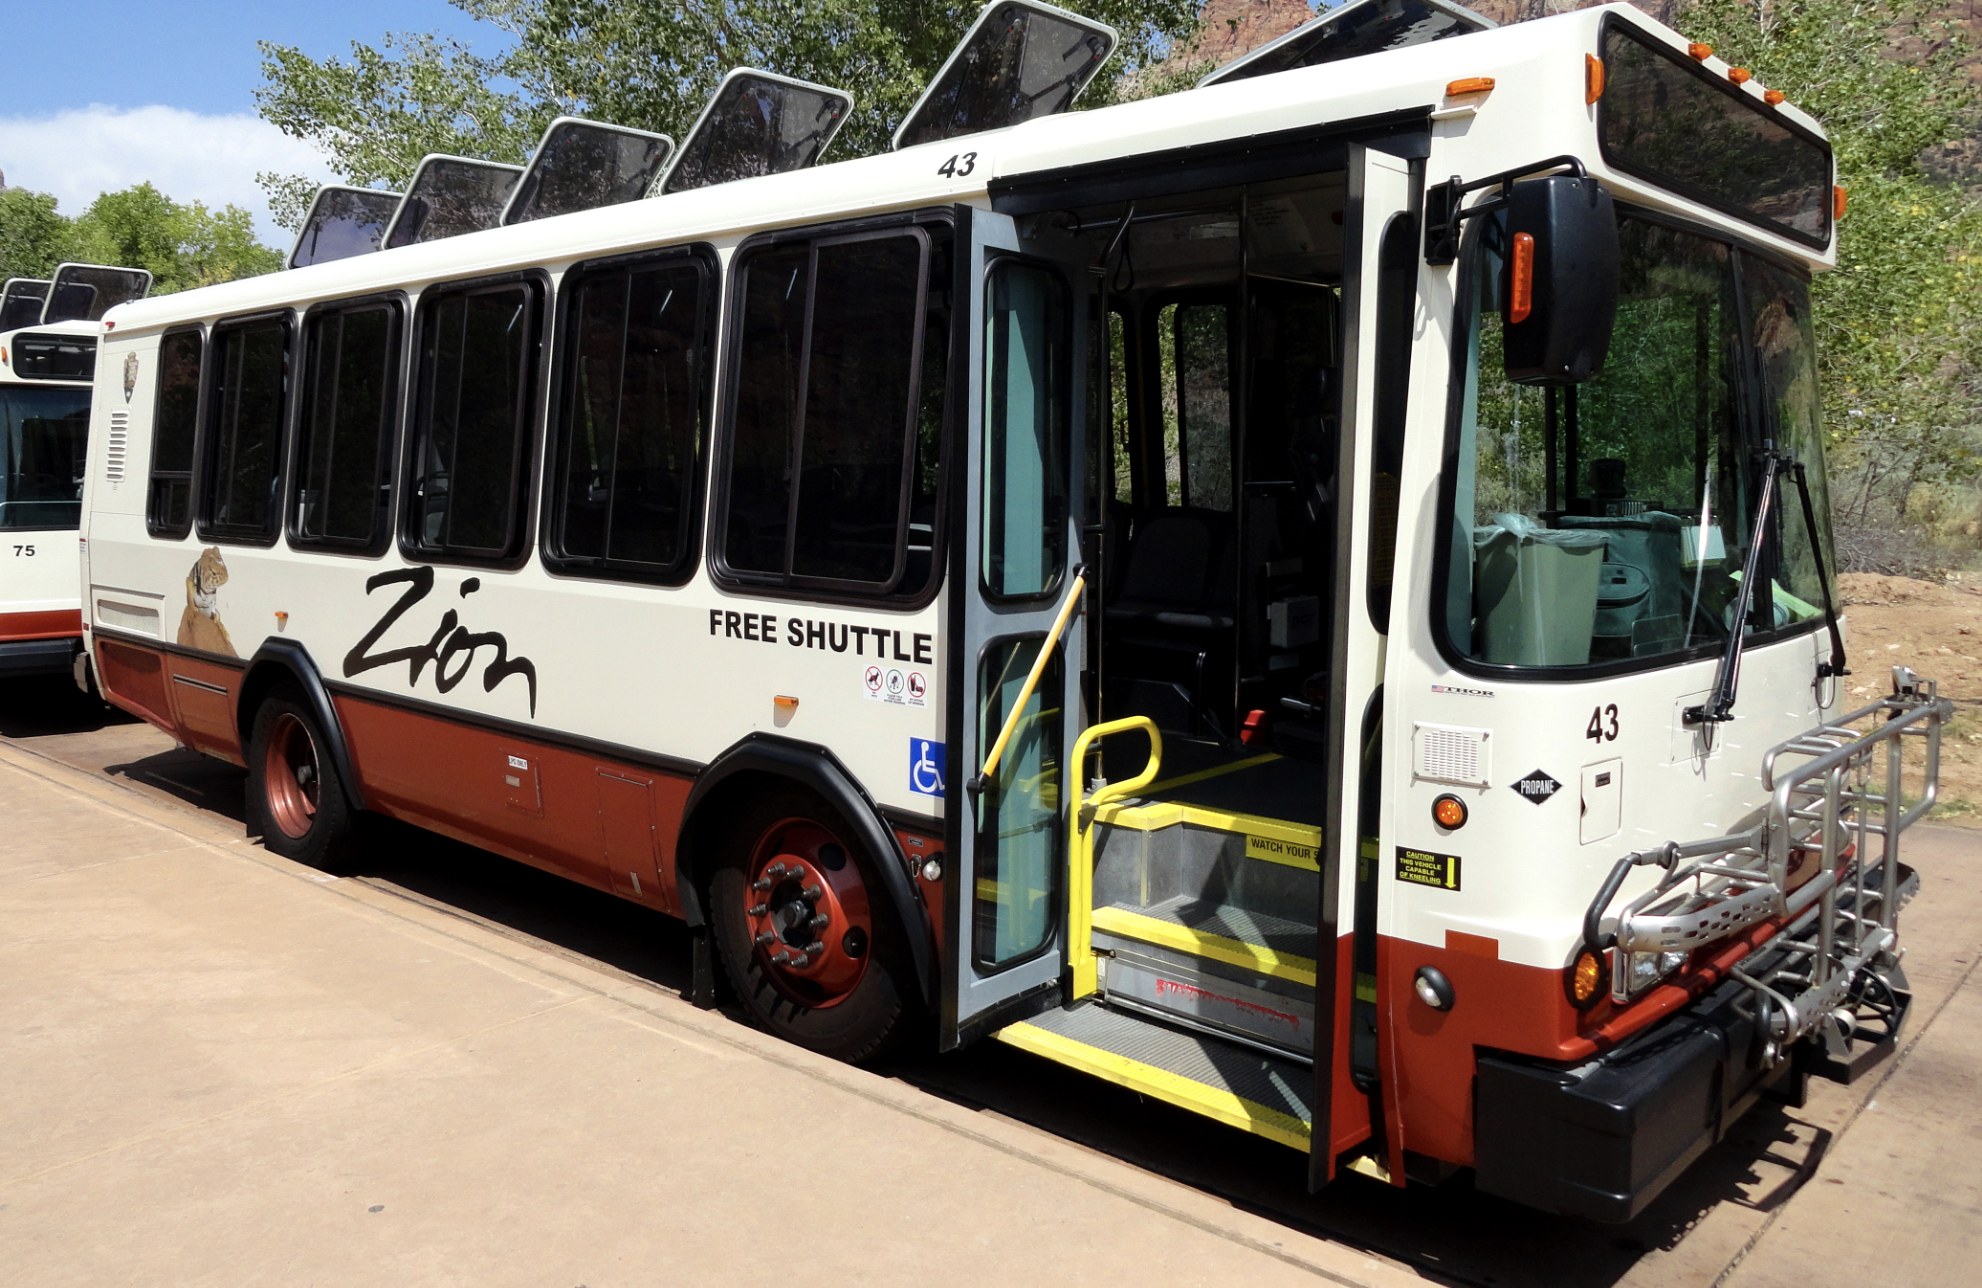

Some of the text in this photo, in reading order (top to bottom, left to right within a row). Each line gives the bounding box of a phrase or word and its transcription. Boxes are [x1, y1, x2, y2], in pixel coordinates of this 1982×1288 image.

[937, 152, 977, 179] 43
[13, 545, 36, 557] 75
[343, 565, 537, 719] Zion
[710, 609, 932, 665] FREE SHUTTLE
[1443, 686, 1495, 696] THOR
[1586, 703, 1619, 744] 43
[1520, 779, 1555, 795] PROPANE
[1251, 837, 1283, 853] WATCH
[1286, 845, 1311, 859] YOUR
[1406, 851, 1434, 862] CAUTION
[1400, 858, 1441, 871] THIS VEHICLE
[1405, 866, 1434, 876] CAPABLE
[1400, 871, 1441, 885] OF KNEELING
